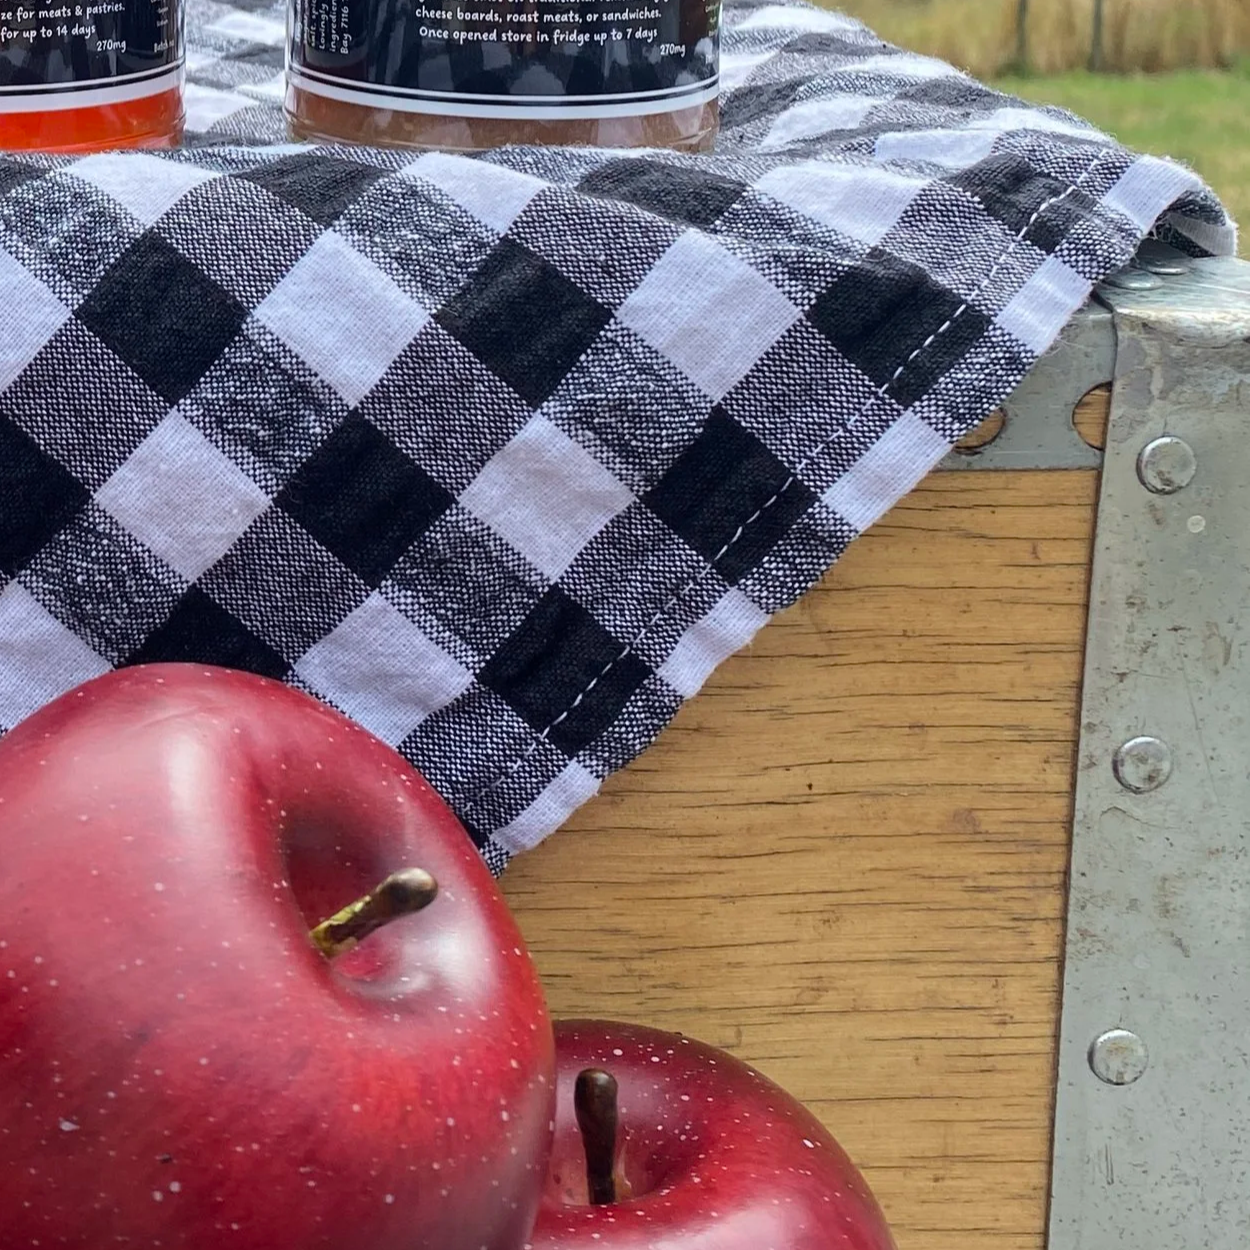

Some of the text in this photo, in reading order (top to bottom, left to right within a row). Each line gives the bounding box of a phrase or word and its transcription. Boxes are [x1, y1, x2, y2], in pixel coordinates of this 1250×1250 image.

[16, 6, 35, 22] for
[38, 7, 72, 20] meats
[75, 5, 83, 17] &
[86, 1, 125, 20] pastries.
[415, 5, 662, 23] cheese boards, roast meats, or sandwiches.
[419, 26, 658, 47] Once opened store in fridge up to 7 days
[97, 39, 127, 53] 270mg
[660, 43, 686, 58] 270mg
